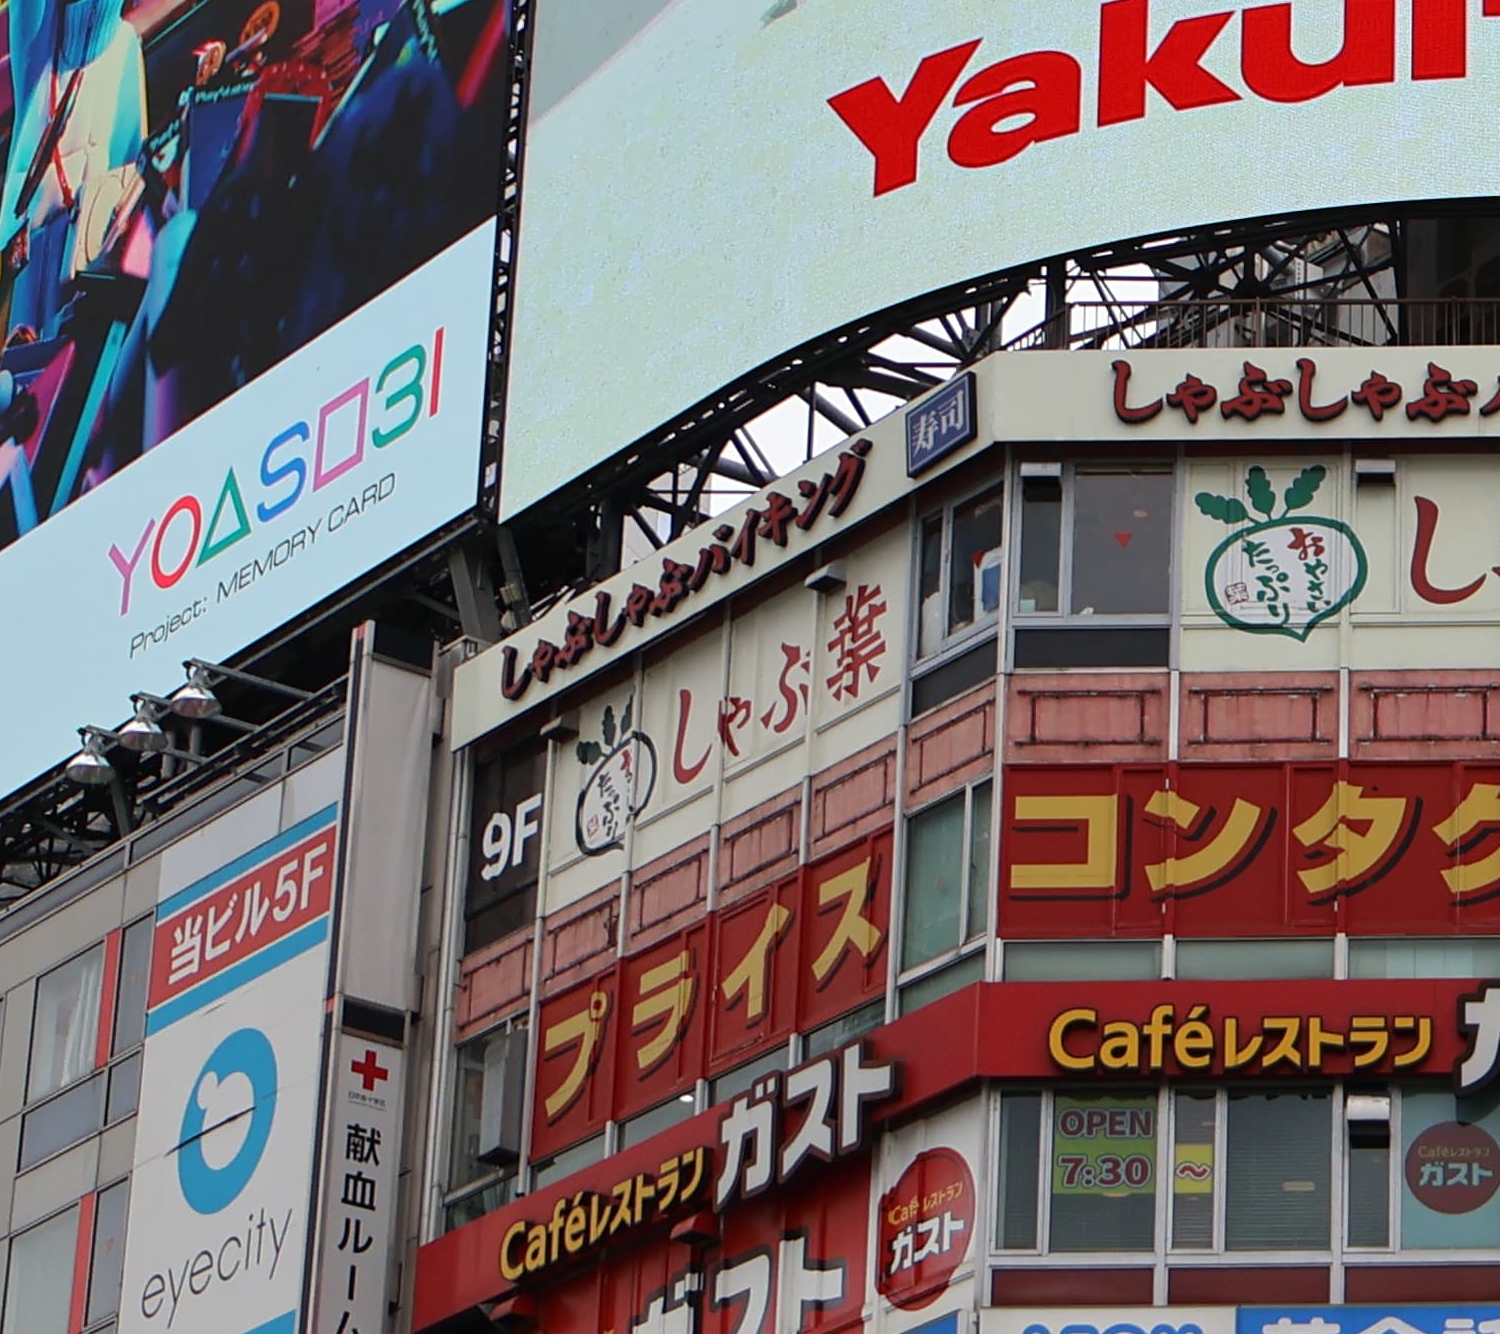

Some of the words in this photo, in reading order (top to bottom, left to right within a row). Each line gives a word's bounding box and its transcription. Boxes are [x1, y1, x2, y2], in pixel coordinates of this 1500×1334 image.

[910, 394, 967, 457] 寿司
[130, 597, 208, 659] Project:
[217, 519, 322, 604] MEMORY
[327, 473, 396, 534] CARD
[500, 439, 873, 700] しゃぶしゃぶバイキング
[672, 584, 889, 784] しゃぶ葉
[481, 793, 543, 881] 9F
[167, 841, 327, 985] 当ビル5F
[544, 856, 882, 1117] プライス
[715, 1041, 891, 1208] ガスト
[1059, 1155, 1150, 1187] 7:30
[1060, 1109, 1152, 1138] OPEN
[1419, 1162, 1493, 1186] ガスト
[141, 1208, 292, 1329] eyecity
[891, 1210, 965, 1275] ガスト
